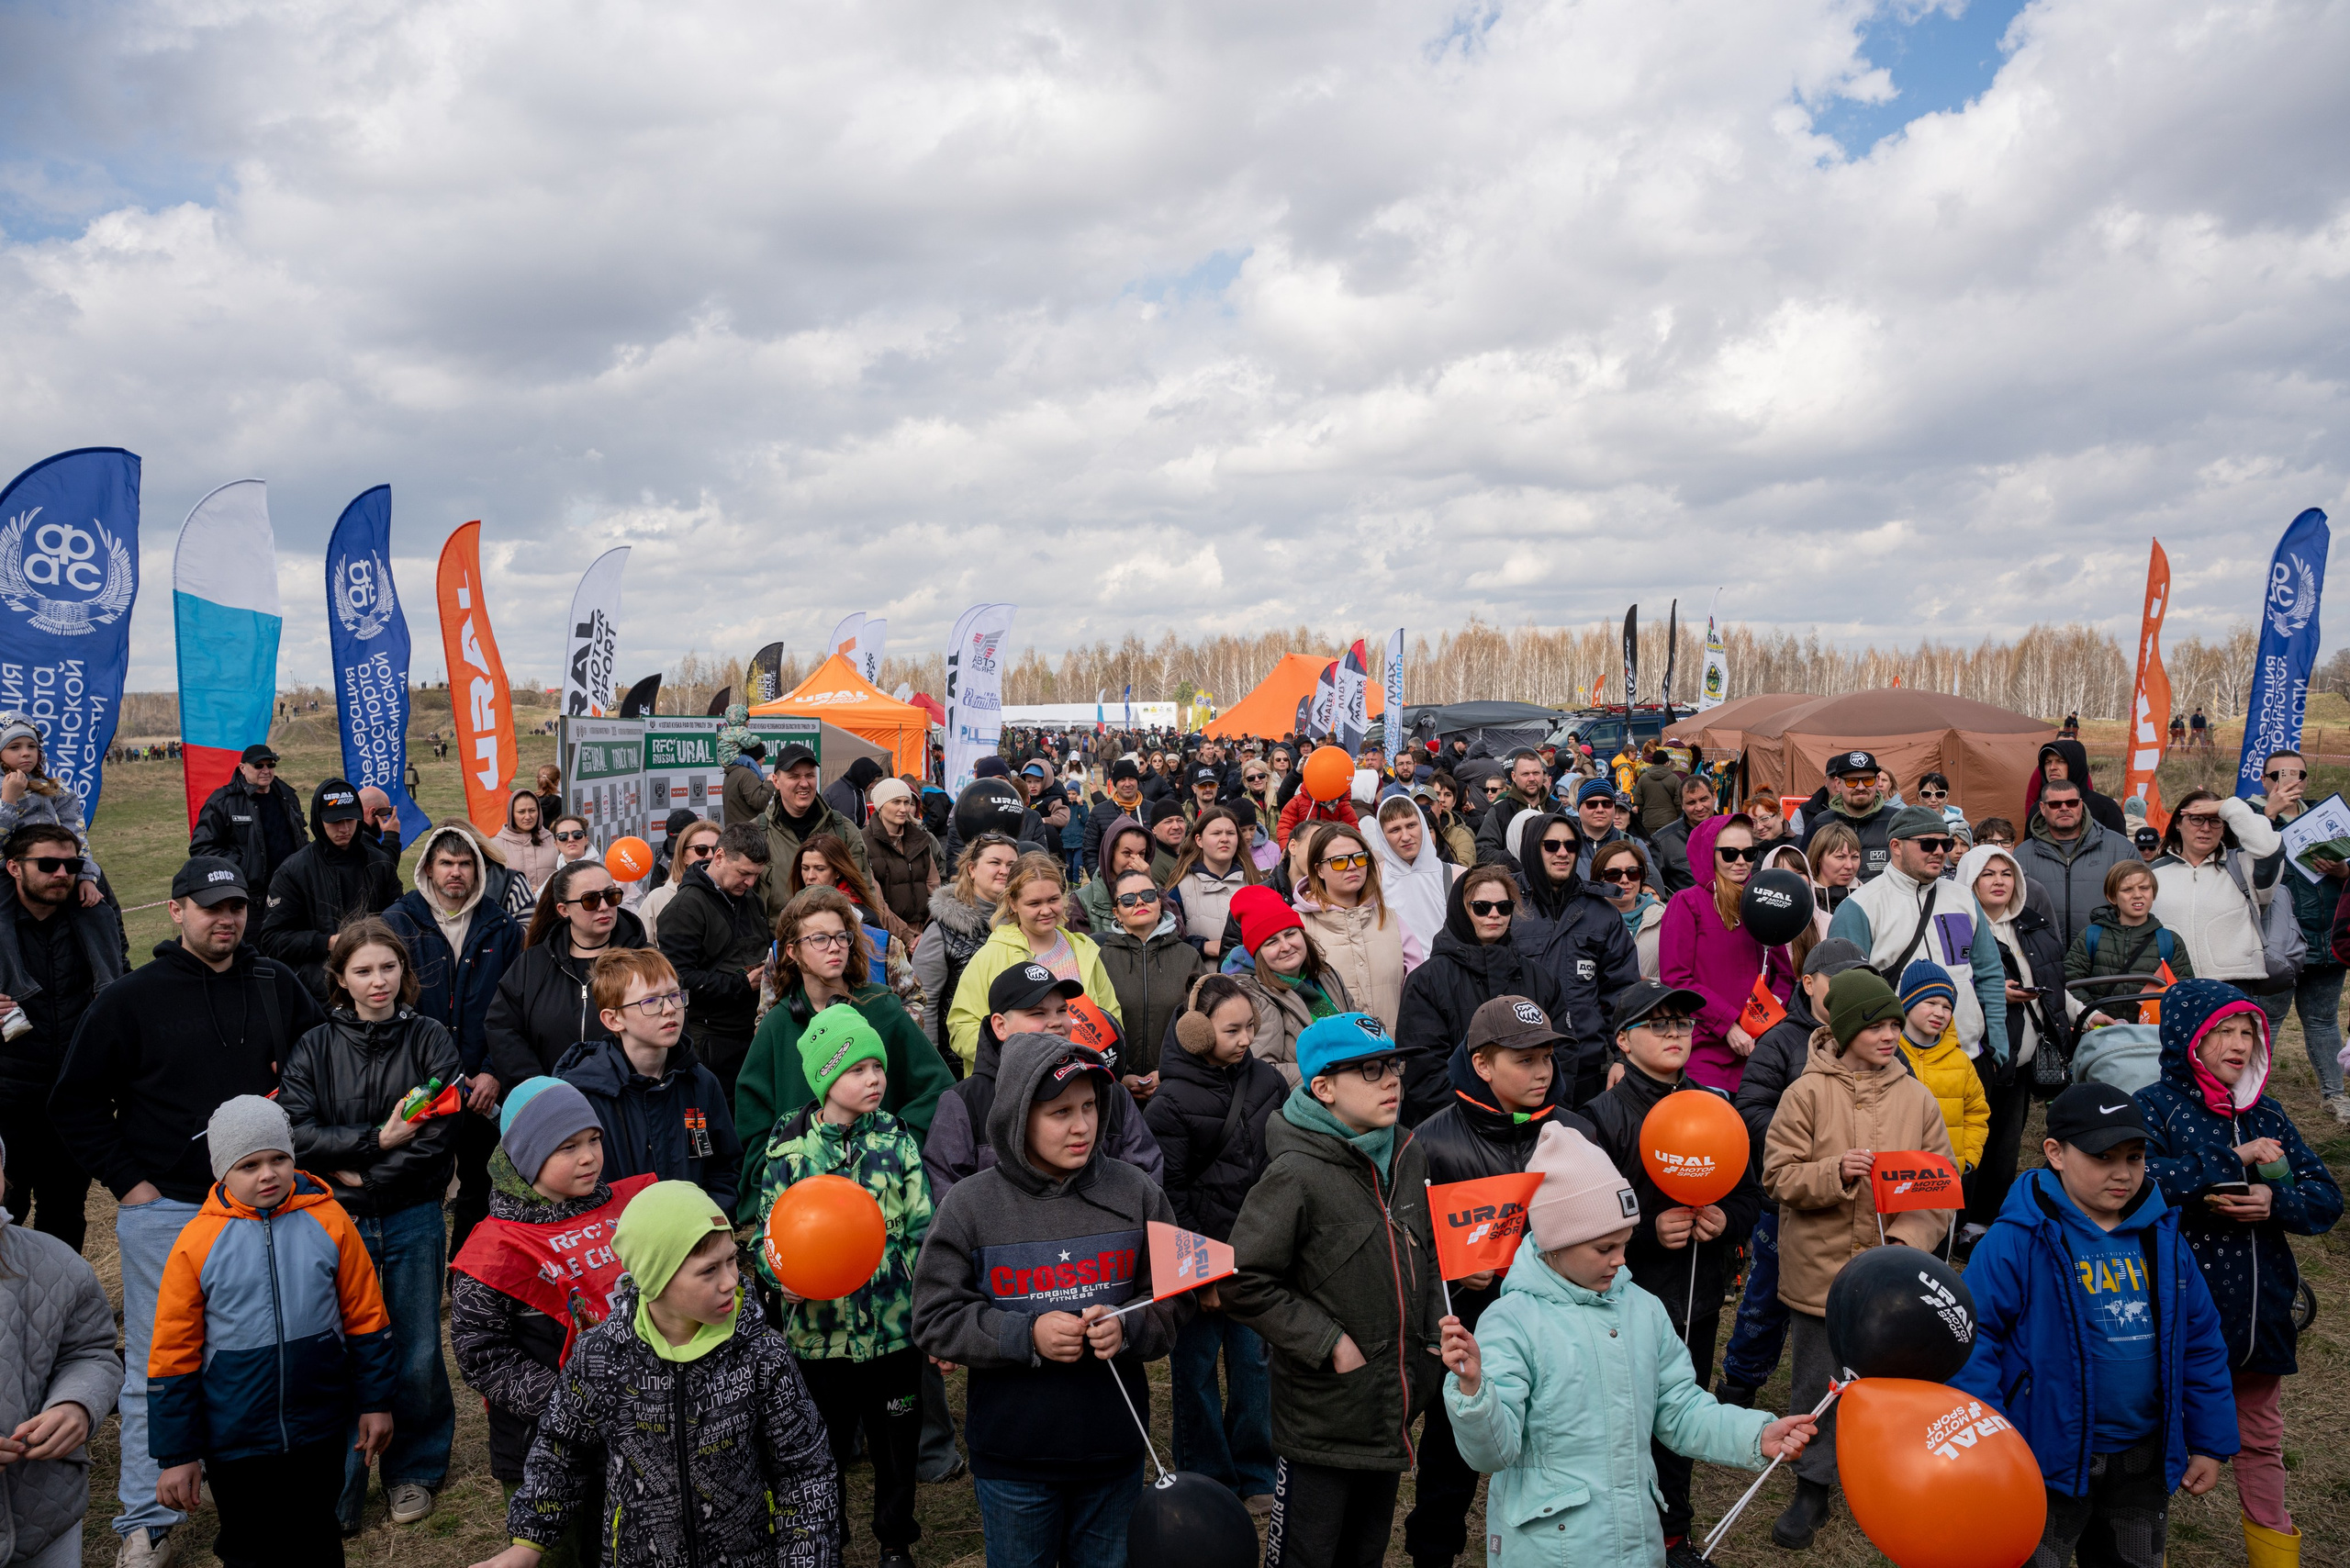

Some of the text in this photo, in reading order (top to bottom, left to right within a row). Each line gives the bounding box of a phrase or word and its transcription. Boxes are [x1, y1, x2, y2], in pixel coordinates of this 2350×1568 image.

[568, 610, 595, 715] RAL
[591, 609, 604, 701] MOTOR
[600, 621, 617, 708] SPORT
[458, 569, 499, 790] URAL
[1387, 661, 1396, 706] MAX
[795, 690, 869, 703] URAL
[1324, 690, 1334, 724] MALEX
[1354, 679, 1363, 721] MALEX
[52, 659, 84, 791] бинской
[345, 666, 376, 788] федерация
[358, 663, 390, 786] автоспорта
[677, 739, 714, 763] URAL
[762, 739, 787, 757] RUCK
[653, 754, 676, 765] RUSSIA
[323, 791, 354, 801] URAL
[990, 797, 1024, 807] URAL
[621, 850, 641, 871] URAL
[1753, 887, 1793, 902] URAL
[1765, 901, 1789, 909] SPORT
[1768, 898, 1792, 906] MOTOR
[1750, 991, 1770, 1022] RAL
[1069, 1003, 1103, 1043] URAL
[1077, 1024, 1099, 1045] MOTOR
[1655, 1149, 1716, 1166] URAL
[1677, 1170, 1711, 1179] SPORT
[1680, 1165, 1716, 1174] MOTOR
[1881, 1168, 1950, 1182] URAL
[1910, 1185, 1948, 1194] SPORT
[1913, 1179, 1952, 1189] MOTOR
[1488, 1226, 1519, 1240] SPOR
[1493, 1216, 1522, 1231] MOTO
[990, 1249, 1136, 1296] CrossFit
[1030, 1282, 1110, 1300] FORGING ELITE
[1049, 1291, 1093, 1303] FITNESS
[1919, 1271, 1974, 1338] URAL
[1937, 1310, 1964, 1343] SPORT
[1944, 1308, 1969, 1343] MOTOR
[711, 1417, 732, 1432] WHAT
[733, 1414, 741, 1424] IT
[1926, 1414, 1970, 1450] MOTOR
[1927, 1406, 1965, 1439] SPORT
[698, 1420, 750, 1448] ACCEPT IT AND
[1933, 1415, 2012, 1461] URAL
[698, 1443, 721, 1457] MOVE
[535, 1486, 573, 1501] MAKE
[786, 1514, 825, 1528] LEVEL
